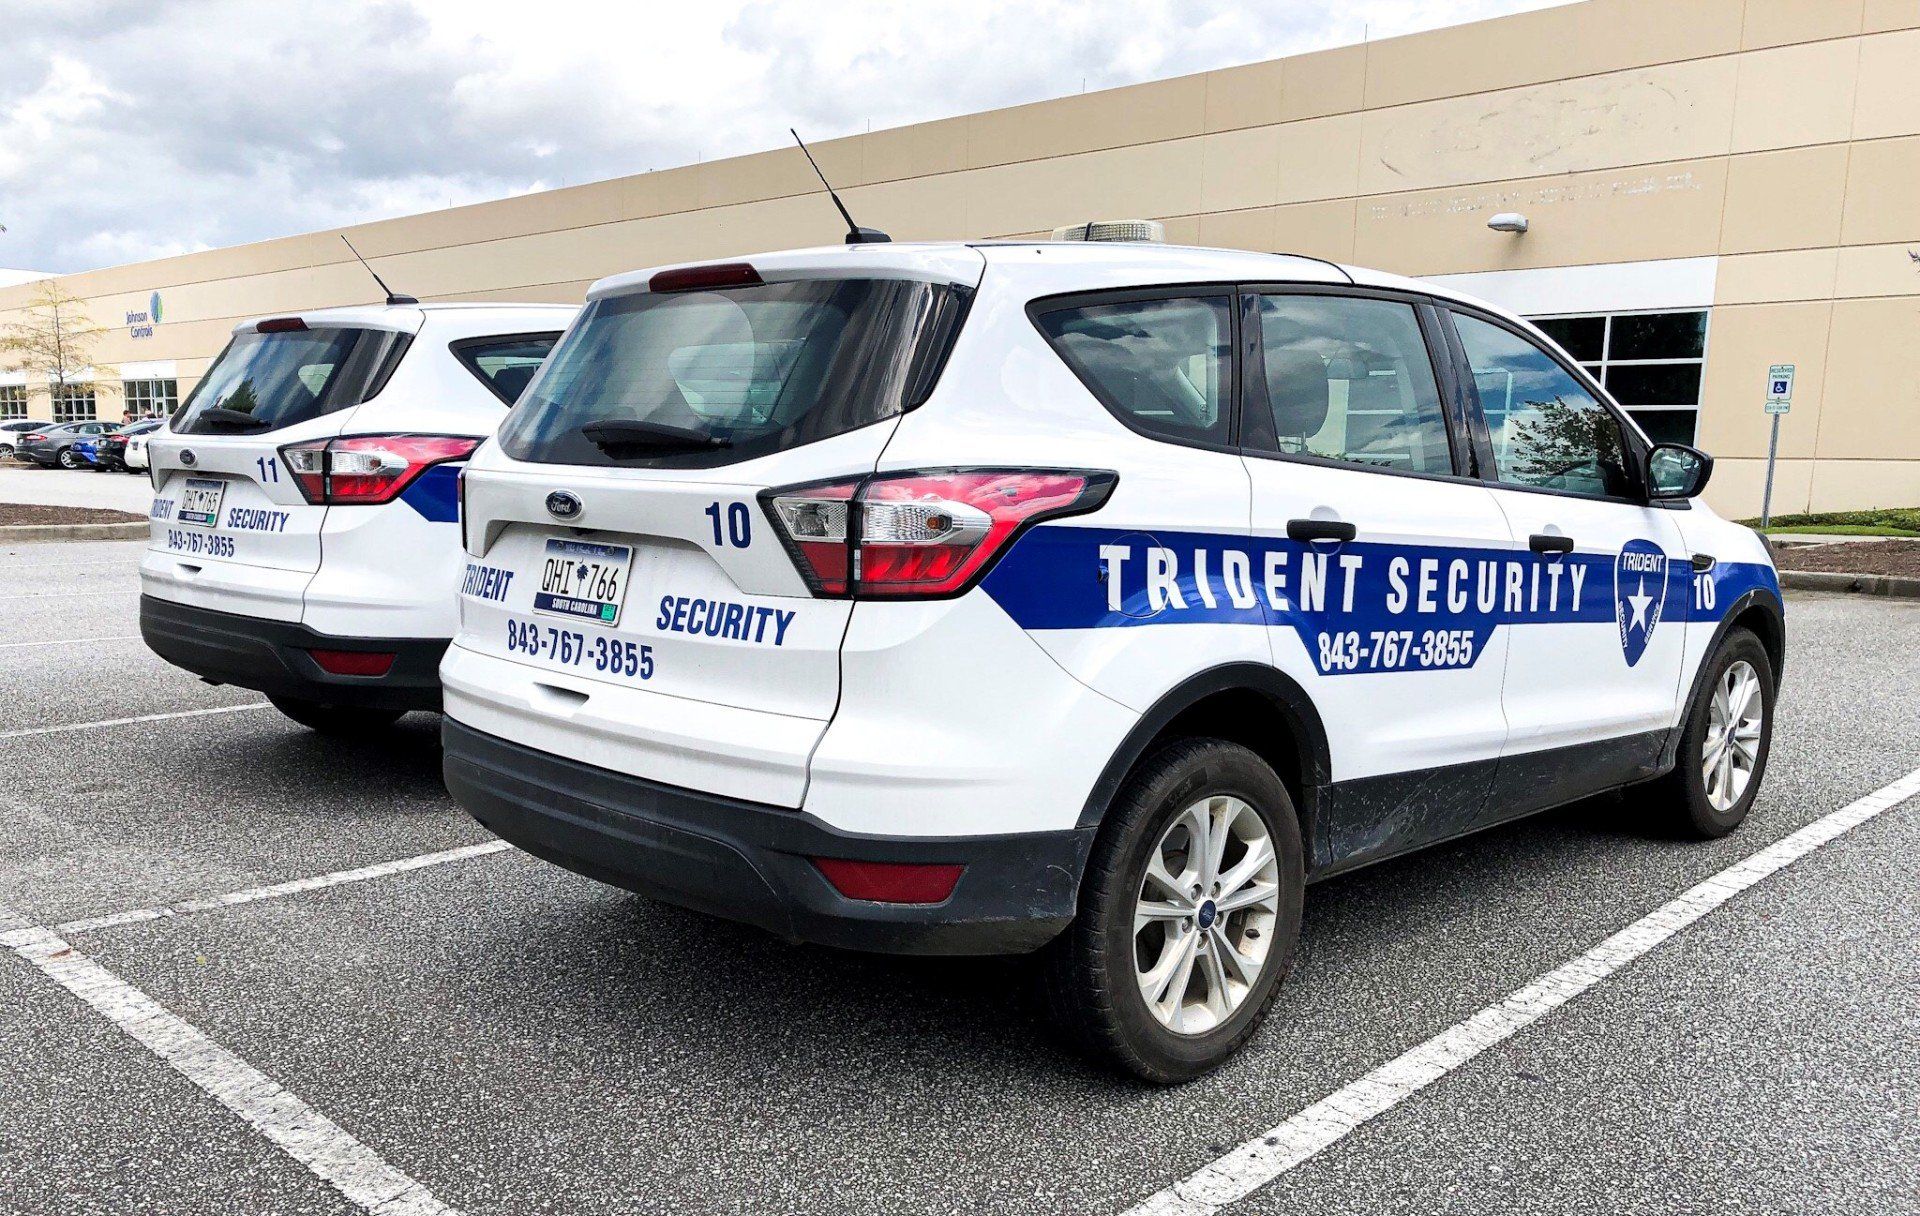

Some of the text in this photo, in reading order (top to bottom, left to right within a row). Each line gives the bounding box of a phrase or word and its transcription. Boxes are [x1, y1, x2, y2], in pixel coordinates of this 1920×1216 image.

[126, 310, 148, 325] Johnson
[131, 324, 153, 338] Controls
[256, 456, 278, 483] 11
[203, 491, 218, 512] 765
[550, 499, 572, 513] Ford
[227, 507, 290, 533] SECURITY
[704, 501, 752, 549] 10
[168, 529, 235, 558] 843-767-3855
[1622, 551, 1665, 573] TRIDENT
[541, 558, 619, 601] QHI 766
[1099, 544, 1588, 615] TRIDENT SECURITY
[1693, 572, 1716, 611] 10
[461, 563, 797, 647] TRIDENT SECURITY
[551, 598, 571, 612] SOUTH
[570, 601, 598, 616] CAROLINA
[507, 619, 654, 680] 843-767-3855
[1317, 629, 1474, 672] 843-767-3855
